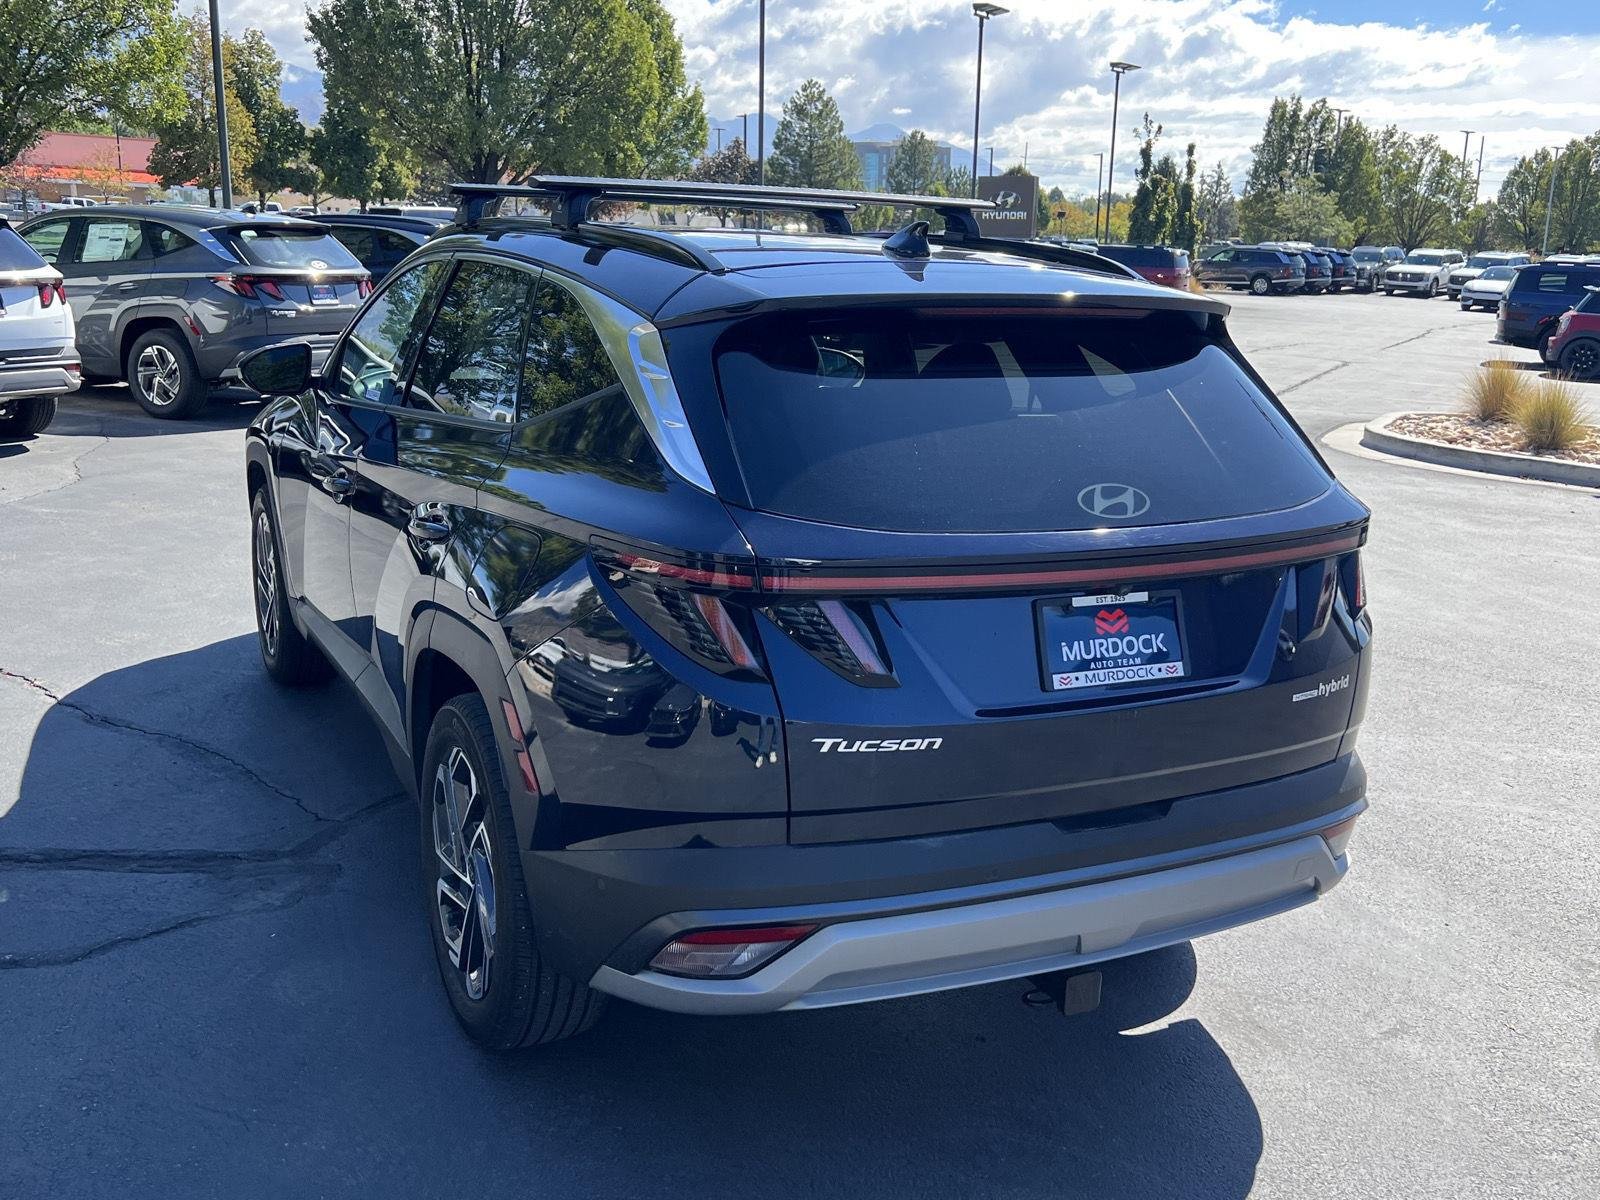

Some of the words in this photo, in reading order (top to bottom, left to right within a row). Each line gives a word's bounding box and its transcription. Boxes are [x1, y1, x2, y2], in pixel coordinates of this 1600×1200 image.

[982, 211, 1027, 220] HYUNDAI
[1110, 594, 1126, 602] 1925
[1061, 633, 1168, 662] MURDOCK
[1089, 660, 1114, 670] AUTO
[1117, 657, 1142, 667] TEAM
[1084, 666, 1156, 684] MURDOCK
[1318, 674, 1350, 697] hybrid
